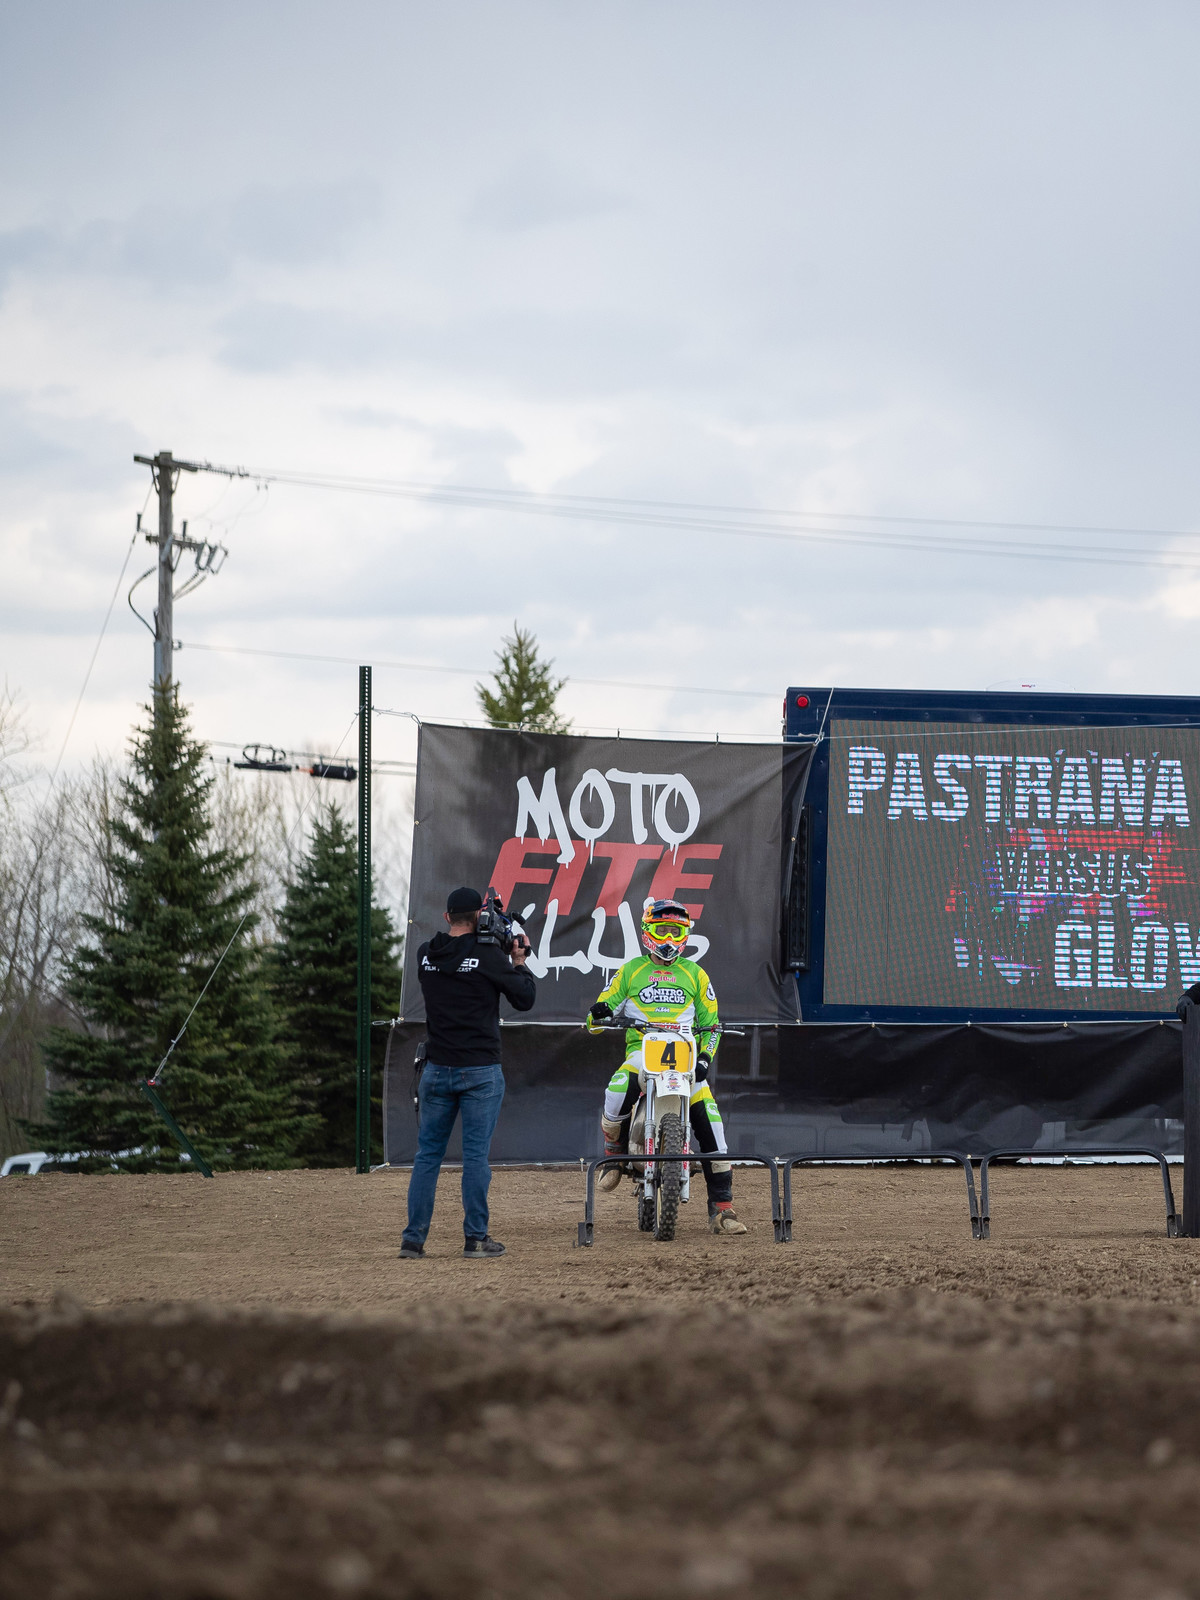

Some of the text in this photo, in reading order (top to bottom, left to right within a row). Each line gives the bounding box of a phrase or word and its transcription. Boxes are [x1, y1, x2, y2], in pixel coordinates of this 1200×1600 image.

[848, 746, 1191, 827] PASTRANA
[515, 767, 700, 868] MOTO
[482, 837, 723, 919] FITE
[996, 851, 1153, 899] VERSUS
[653, 988, 684, 996] NITRO
[653, 996, 686, 1004] CIRCUS
[660, 1041, 676, 1070] 4
